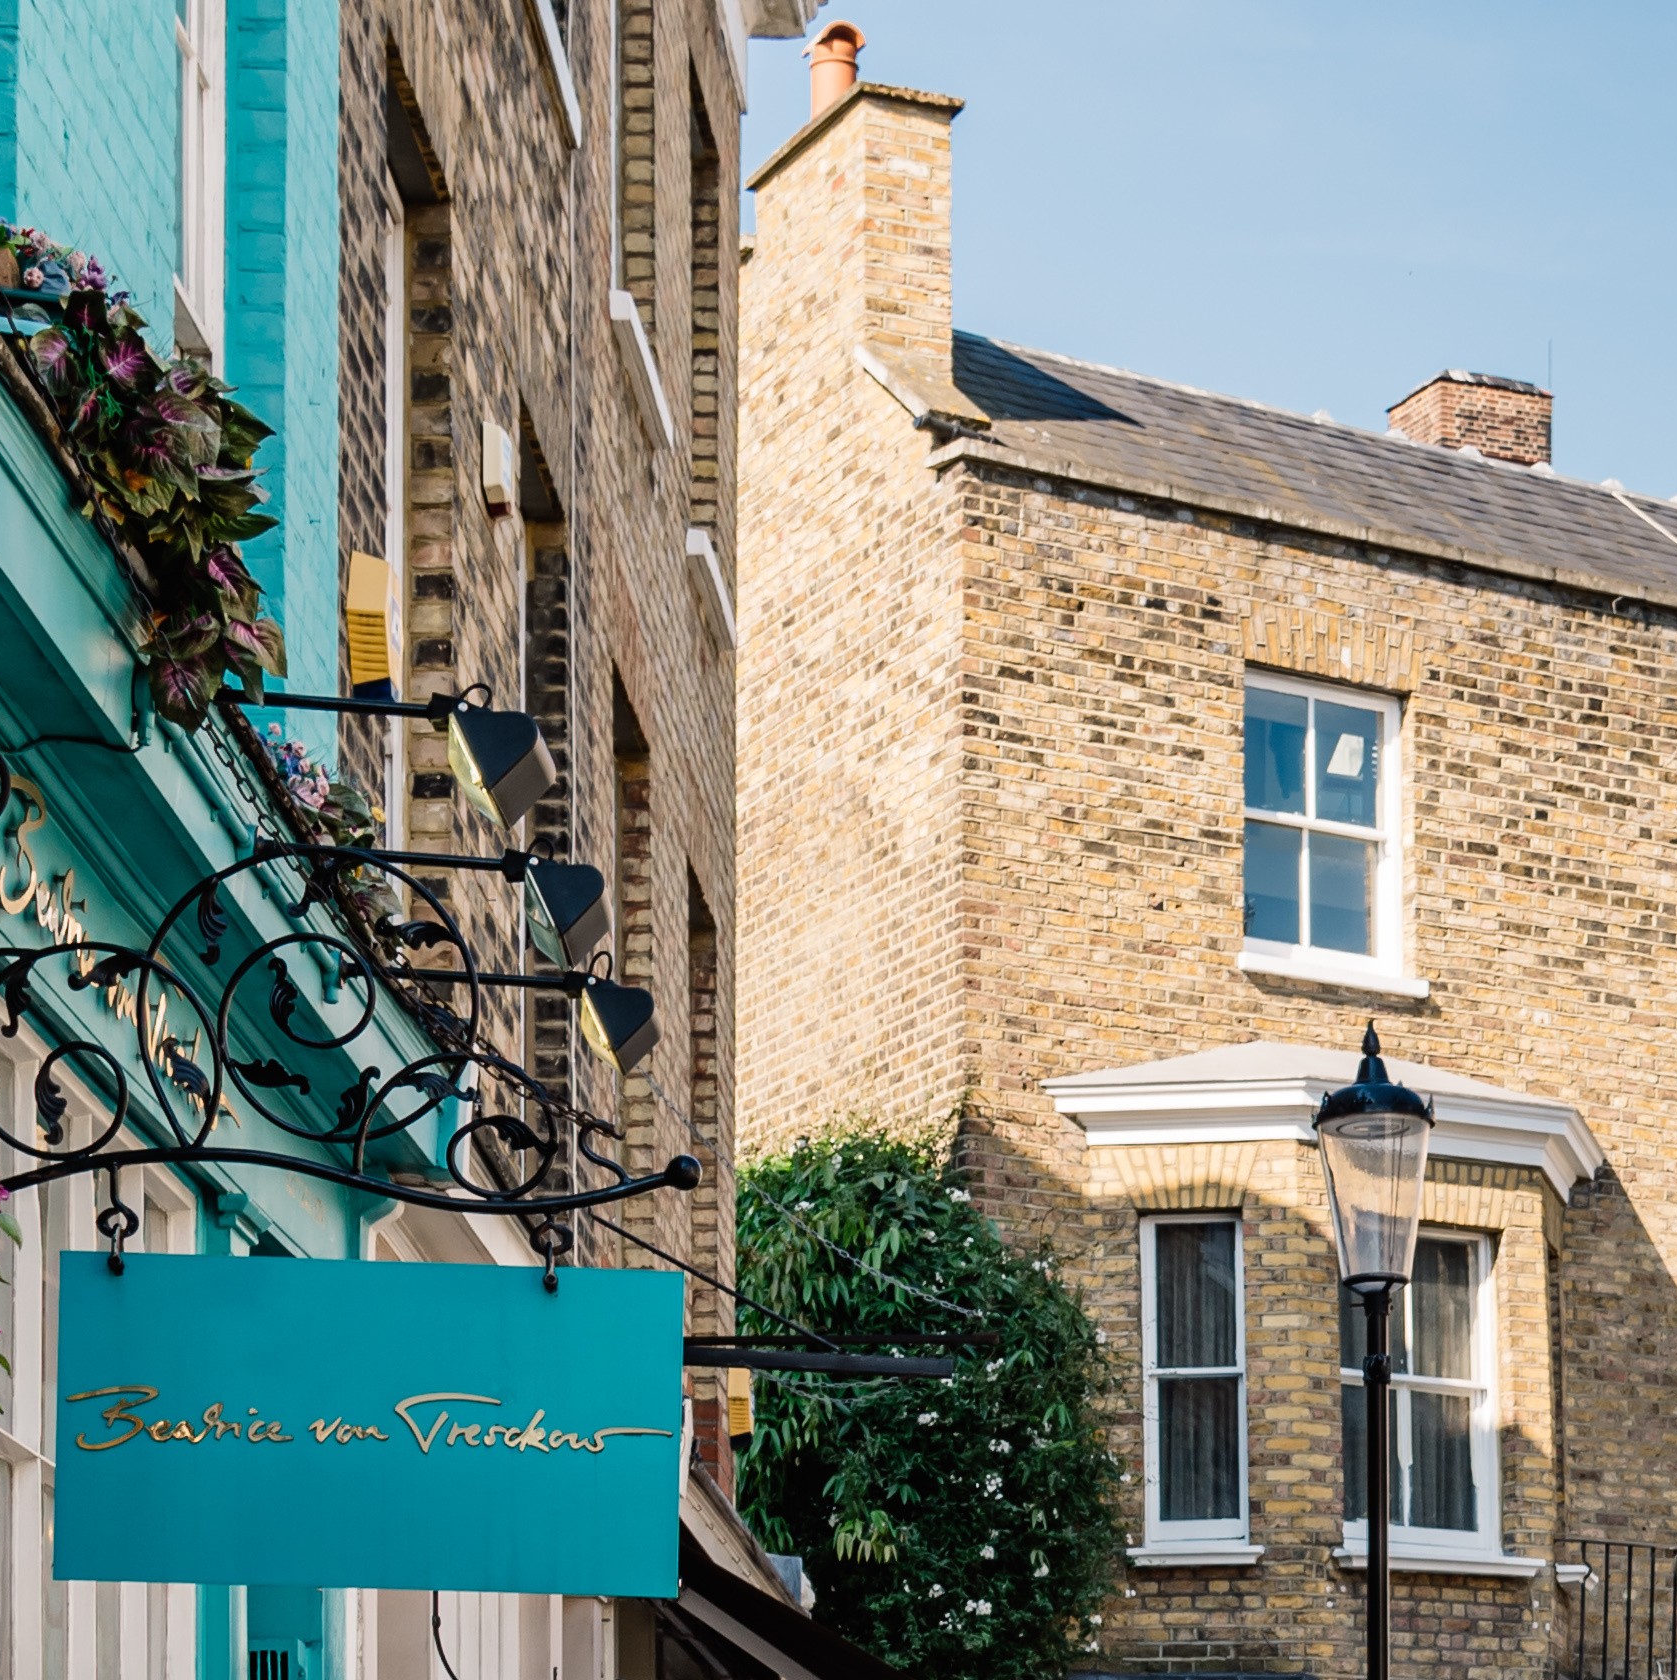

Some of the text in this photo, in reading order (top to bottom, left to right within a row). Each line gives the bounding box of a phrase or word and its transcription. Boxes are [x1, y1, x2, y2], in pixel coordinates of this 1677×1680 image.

[65, 1384, 673, 1454] Beatrice von Tresckow
